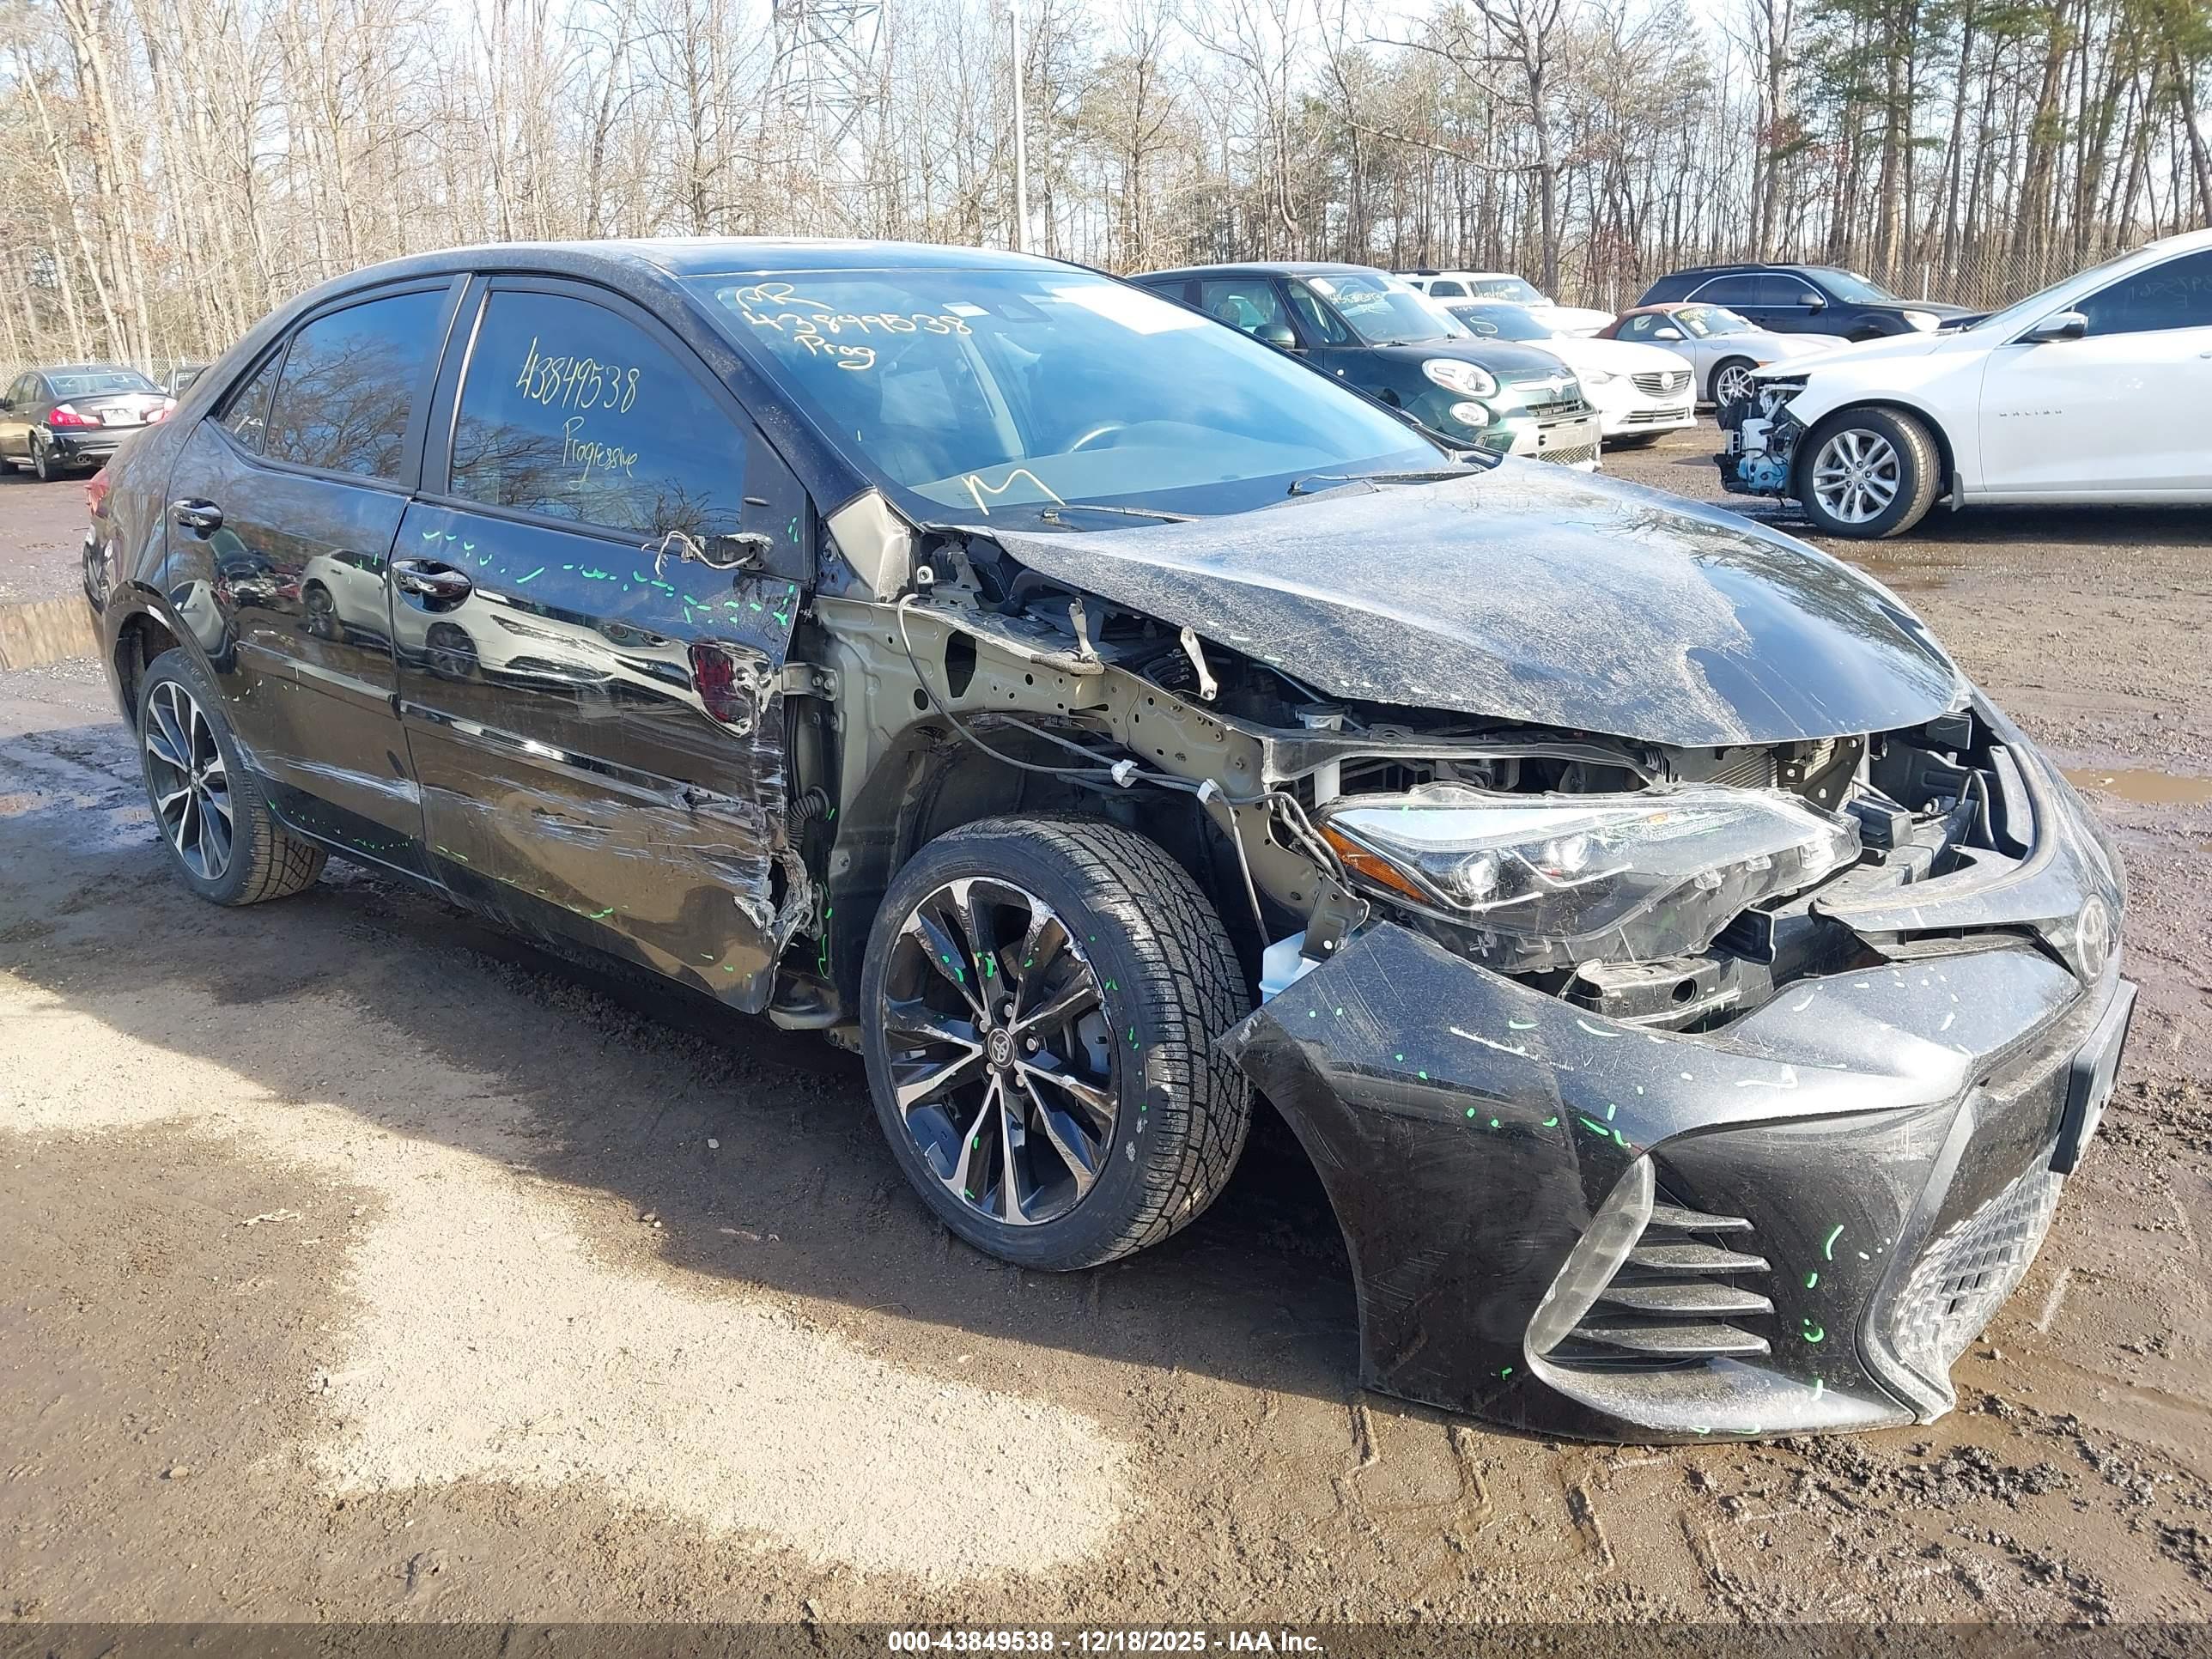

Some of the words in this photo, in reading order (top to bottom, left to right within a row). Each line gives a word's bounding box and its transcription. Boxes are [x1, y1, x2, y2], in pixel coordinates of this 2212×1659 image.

[742, 312, 973, 334] 43849538
[794, 334, 877, 370] Prog
[515, 336, 641, 413] 43849538
